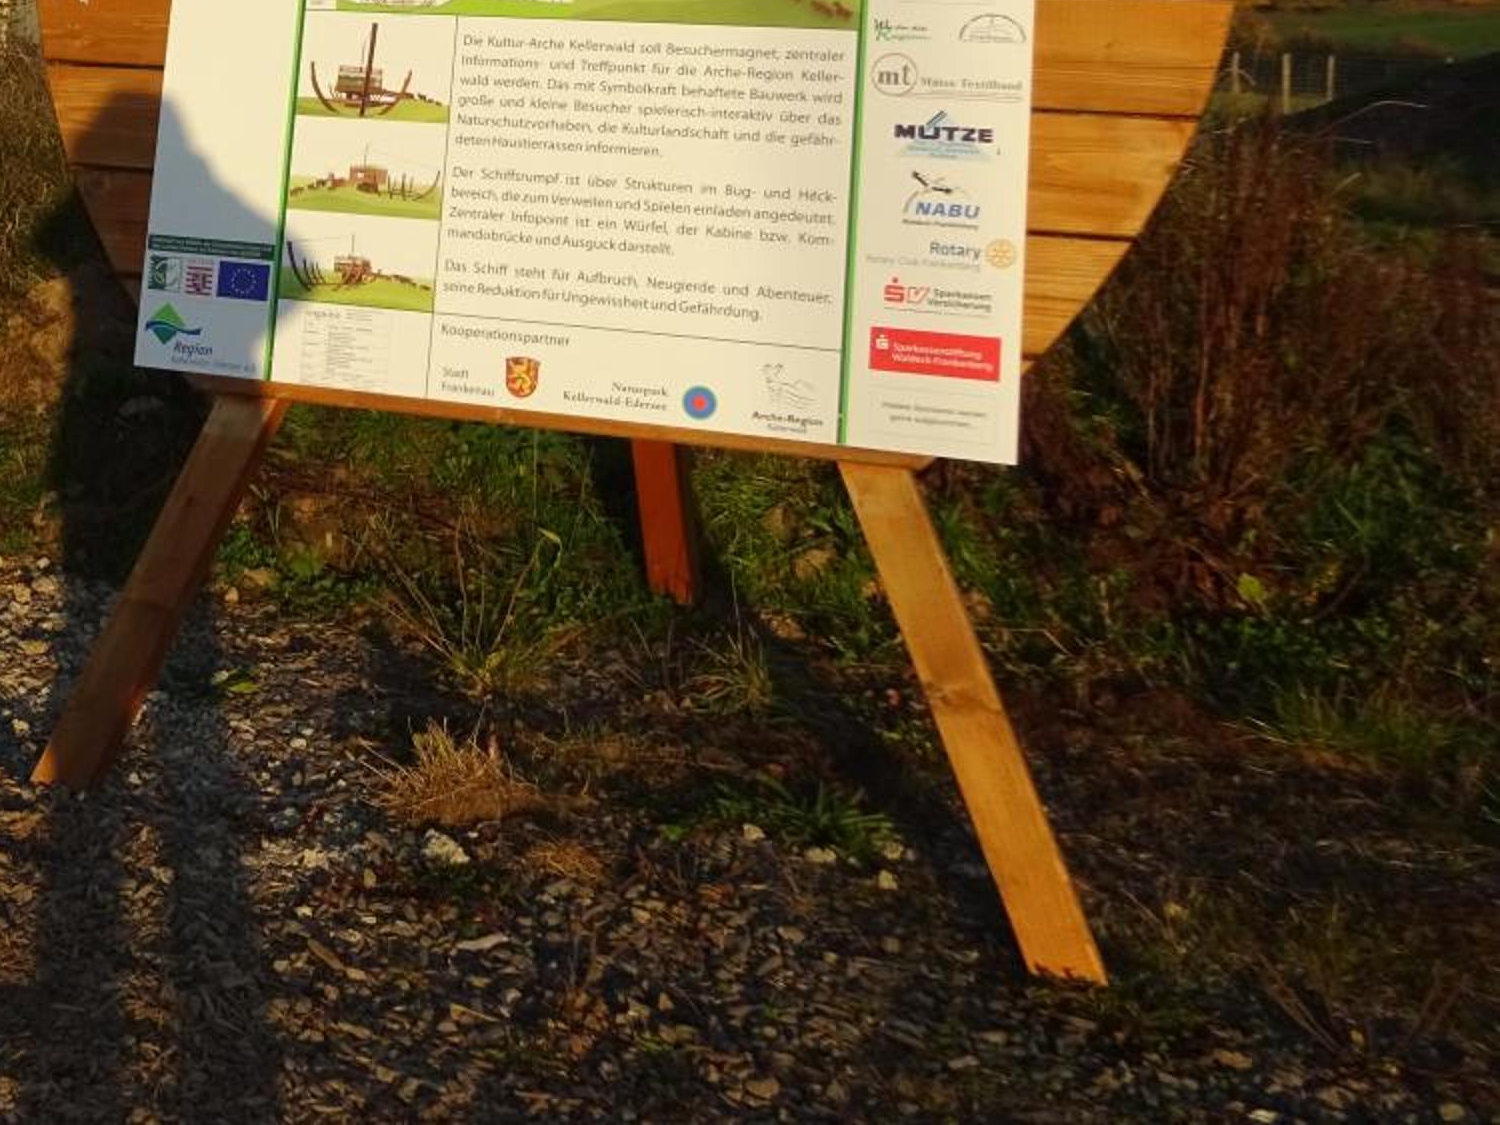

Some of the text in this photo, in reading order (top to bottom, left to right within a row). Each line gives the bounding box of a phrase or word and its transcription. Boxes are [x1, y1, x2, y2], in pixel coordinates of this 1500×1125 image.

[463, 35, 845, 63] Die Kultur-Arche Kellerwald soll Besuchermagnet, zentraler
[549, 59, 575, 71] und
[581, 59, 647, 75] Treffpunkt
[651, 63, 671, 76] für
[676, 64, 697, 77] die
[703, 66, 794, 81] Arche-Region
[801, 70, 846, 83] Keller-
[459, 74, 843, 105] wald werden. Das mit Symbolkraft behaftete Bauwerk wird
[457, 94, 842, 126] große und kleine Besucher spielerisch-interaktiv über das
[457, 114, 593, 134] Naturschutzvorhaben,
[597, 121, 617, 134] die
[621, 123, 730, 141] Kulturlandschaft
[733, 129, 760, 143] und
[765, 131, 786, 144] die
[455, 134, 491, 146] deten
[492, 134, 583, 152] Haustierrassen
[452, 166, 474, 179] Der
[481, 167, 560, 185] Schiffsrumpf
[565, 173, 580, 186] ist
[587, 175, 618, 188] über
[625, 177, 693, 194] Strukturen
[725, 184, 757, 199] Bug-
[764, 187, 791, 201] und
[798, 189, 837, 203] Heck-
[451, 186, 497, 202] bereich,
[501, 189, 521, 202] die
[522, 192, 549, 204] zum
[551, 192, 613, 209] Verweilen
[615, 196, 641, 211] und
[642, 199, 691, 215] Spielen
[693, 203, 750, 219] einladen
[915, 202, 981, 219] NABU
[449, 206, 504, 221] Zentraler
[511, 210, 569, 226] Infopoint
[575, 215, 590, 228] ist
[597, 219, 618, 231] ein
[623, 219, 668, 235] Würfel,
[676, 223, 698, 236] der
[705, 225, 753, 240] Kabine
[759, 229, 791, 244] bzw.
[535, 232, 561, 247] und
[562, 235, 616, 252] Ausguck
[617, 238, 675, 256] darstellt.
[929, 241, 982, 260] Rotary
[445, 259, 467, 273] Das
[473, 261, 509, 276] Schiff
[514, 265, 545, 280] steht
[551, 267, 570, 281] für
[577, 270, 638, 289] Aufbruch,
[647, 277, 716, 294] Neugierde
[722, 285, 749, 298] und
[443, 281, 763, 322] seine Reduktion für Ungewissheit und Gefährdung.
[441, 322, 571, 347] Kooperationspartner
[441, 381, 495, 396] Frankenau
[563, 390, 668, 412] Kellerwald-Edersee
[611, 381, 669, 398] Naturpark
